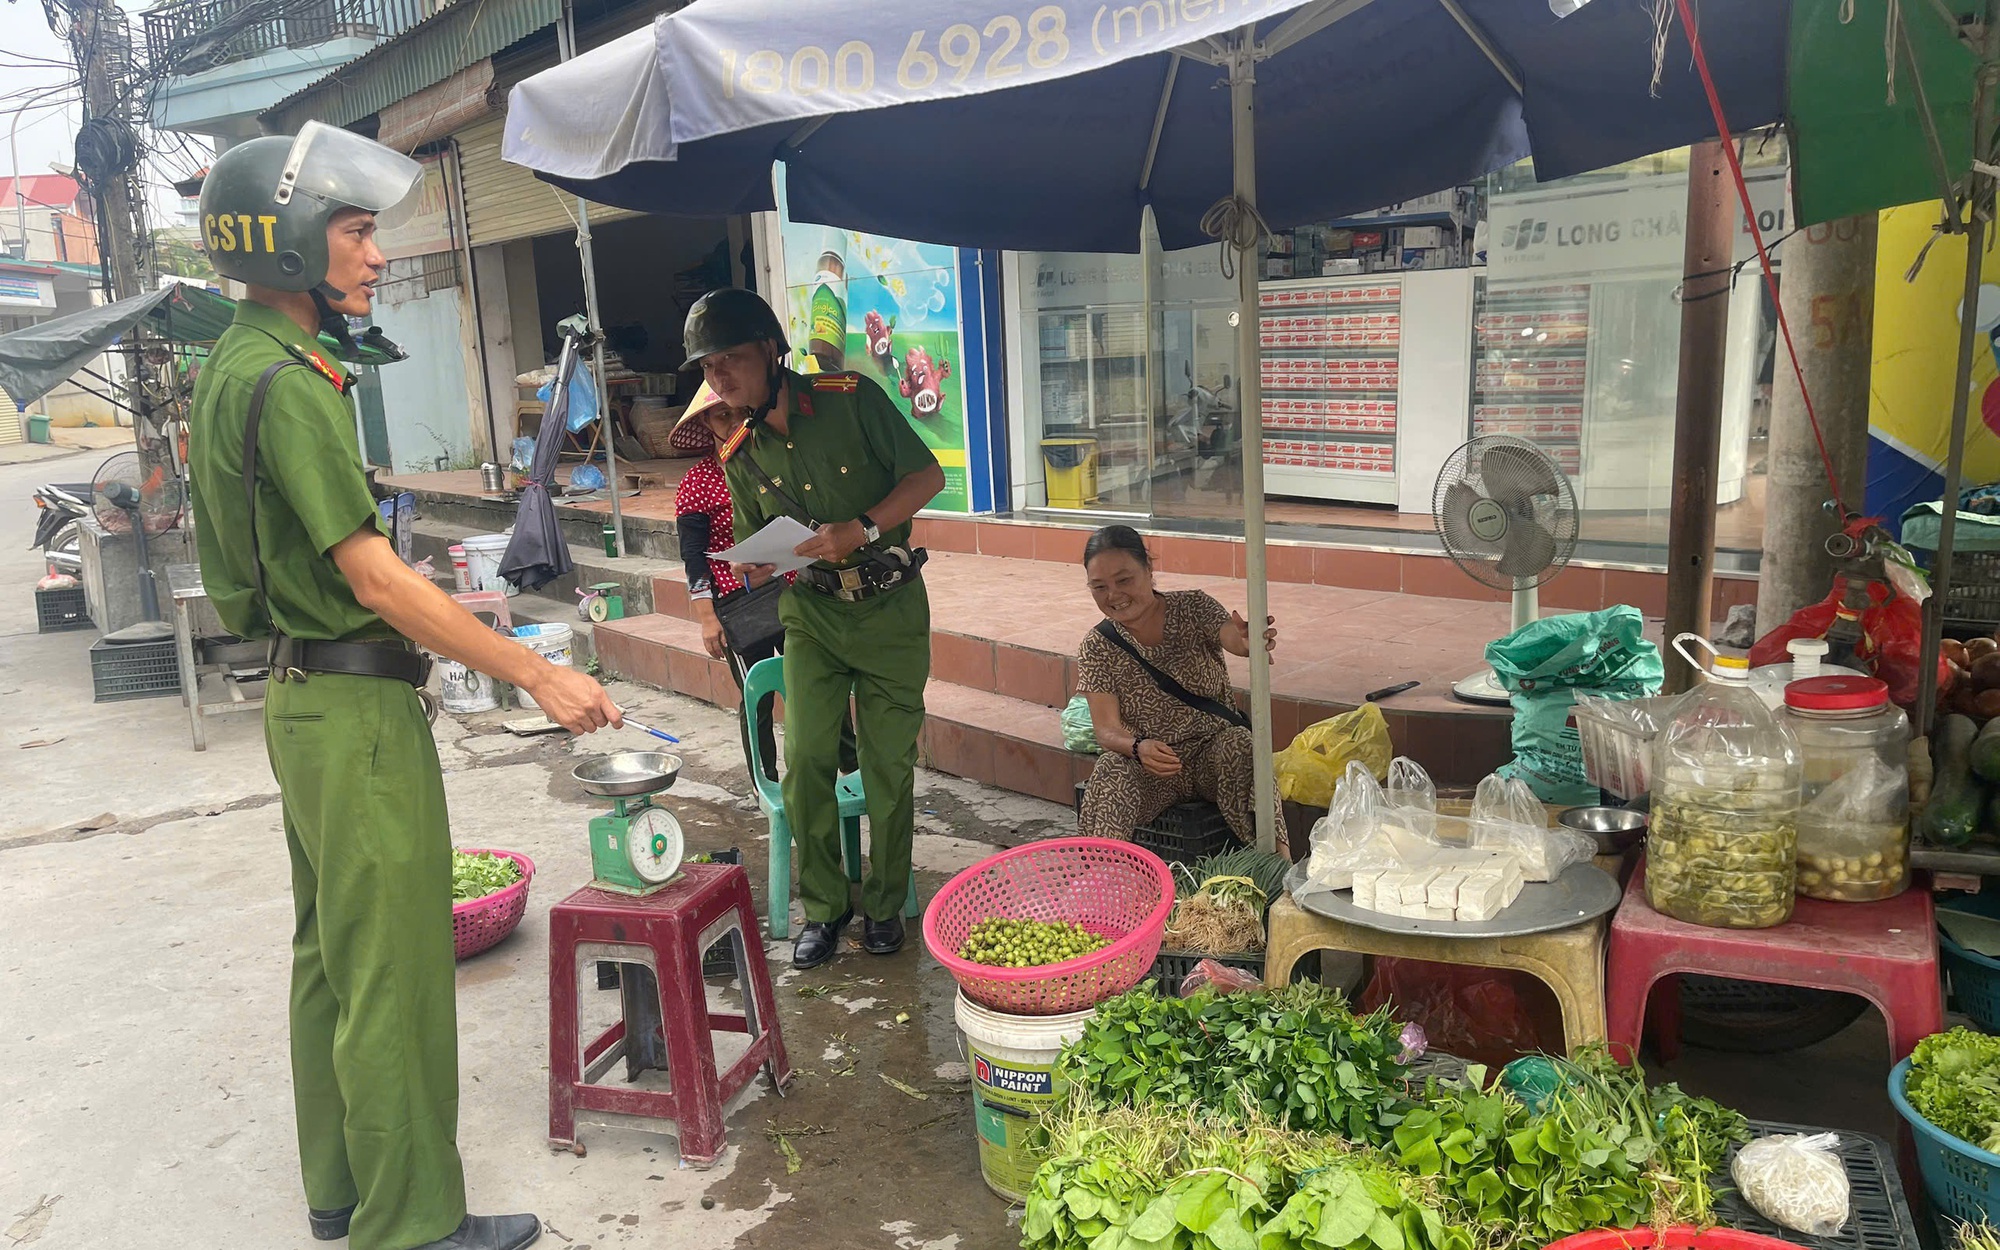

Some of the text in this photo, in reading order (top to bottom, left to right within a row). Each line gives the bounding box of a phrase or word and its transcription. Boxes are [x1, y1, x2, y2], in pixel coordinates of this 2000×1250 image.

[719, 41, 874, 98] 1800
[896, 6, 1069, 90] 6928
[204, 213, 277, 253] CSTT
[1557, 221, 1621, 247] LONG
[995, 1067, 1047, 1083] NIPPON
[1000, 1078, 1041, 1092] PAINT
